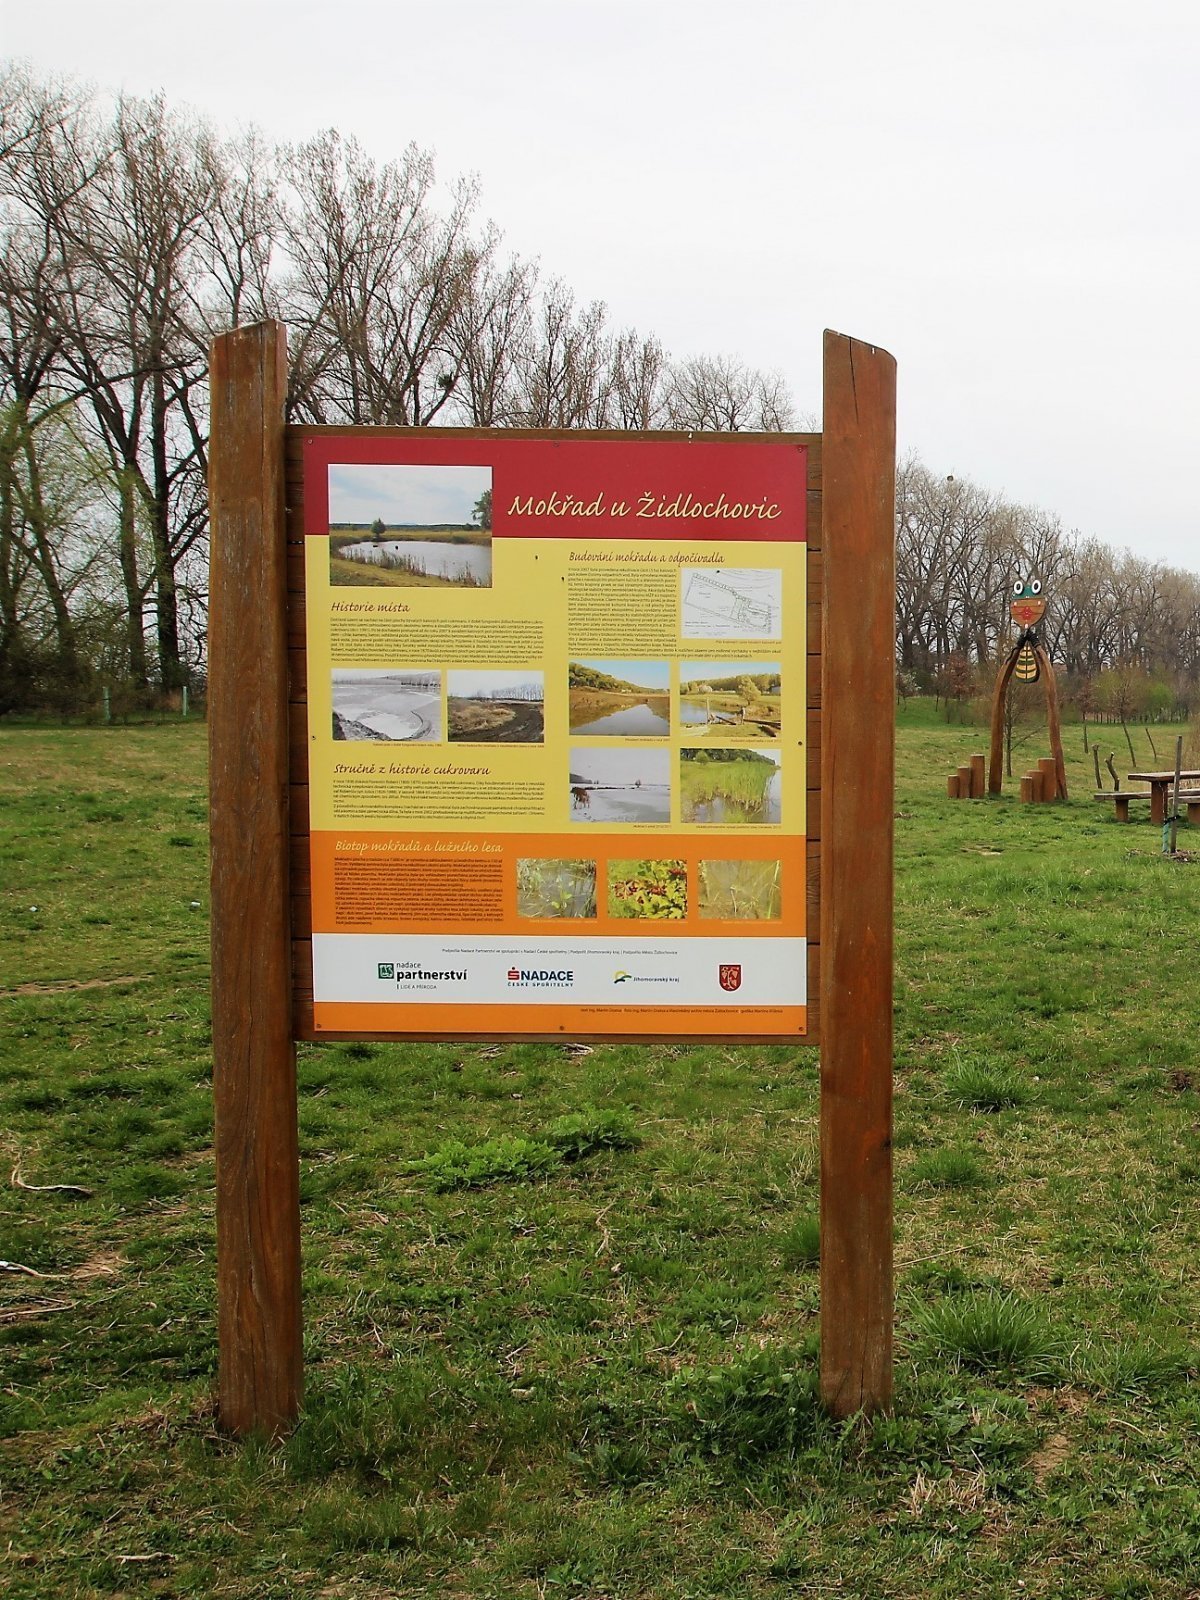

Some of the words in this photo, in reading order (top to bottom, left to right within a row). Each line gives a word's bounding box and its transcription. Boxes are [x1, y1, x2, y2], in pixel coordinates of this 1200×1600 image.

[508, 491, 606, 517] Mokřad
[610, 499, 630, 517] u
[636, 491, 782, 519] Židlochovic
[569, 550, 613, 561] Budování
[615, 551, 658, 562] mokřadu
[668, 551, 725, 567] odpočívadla
[331, 601, 375, 612] Historie
[377, 602, 410, 612] místa
[334, 763, 376, 774] Stručně
[378, 765, 385, 774] z
[389, 763, 430, 774] historie
[433, 764, 490, 775] cukrovaru
[335, 840, 369, 855] Biotop
[371, 840, 422, 851] mokřadů
[434, 840, 478, 852] lužního
[482, 841, 503, 852] lesa
[397, 969, 468, 982] partnerství
[521, 971, 573, 980] NADACE
